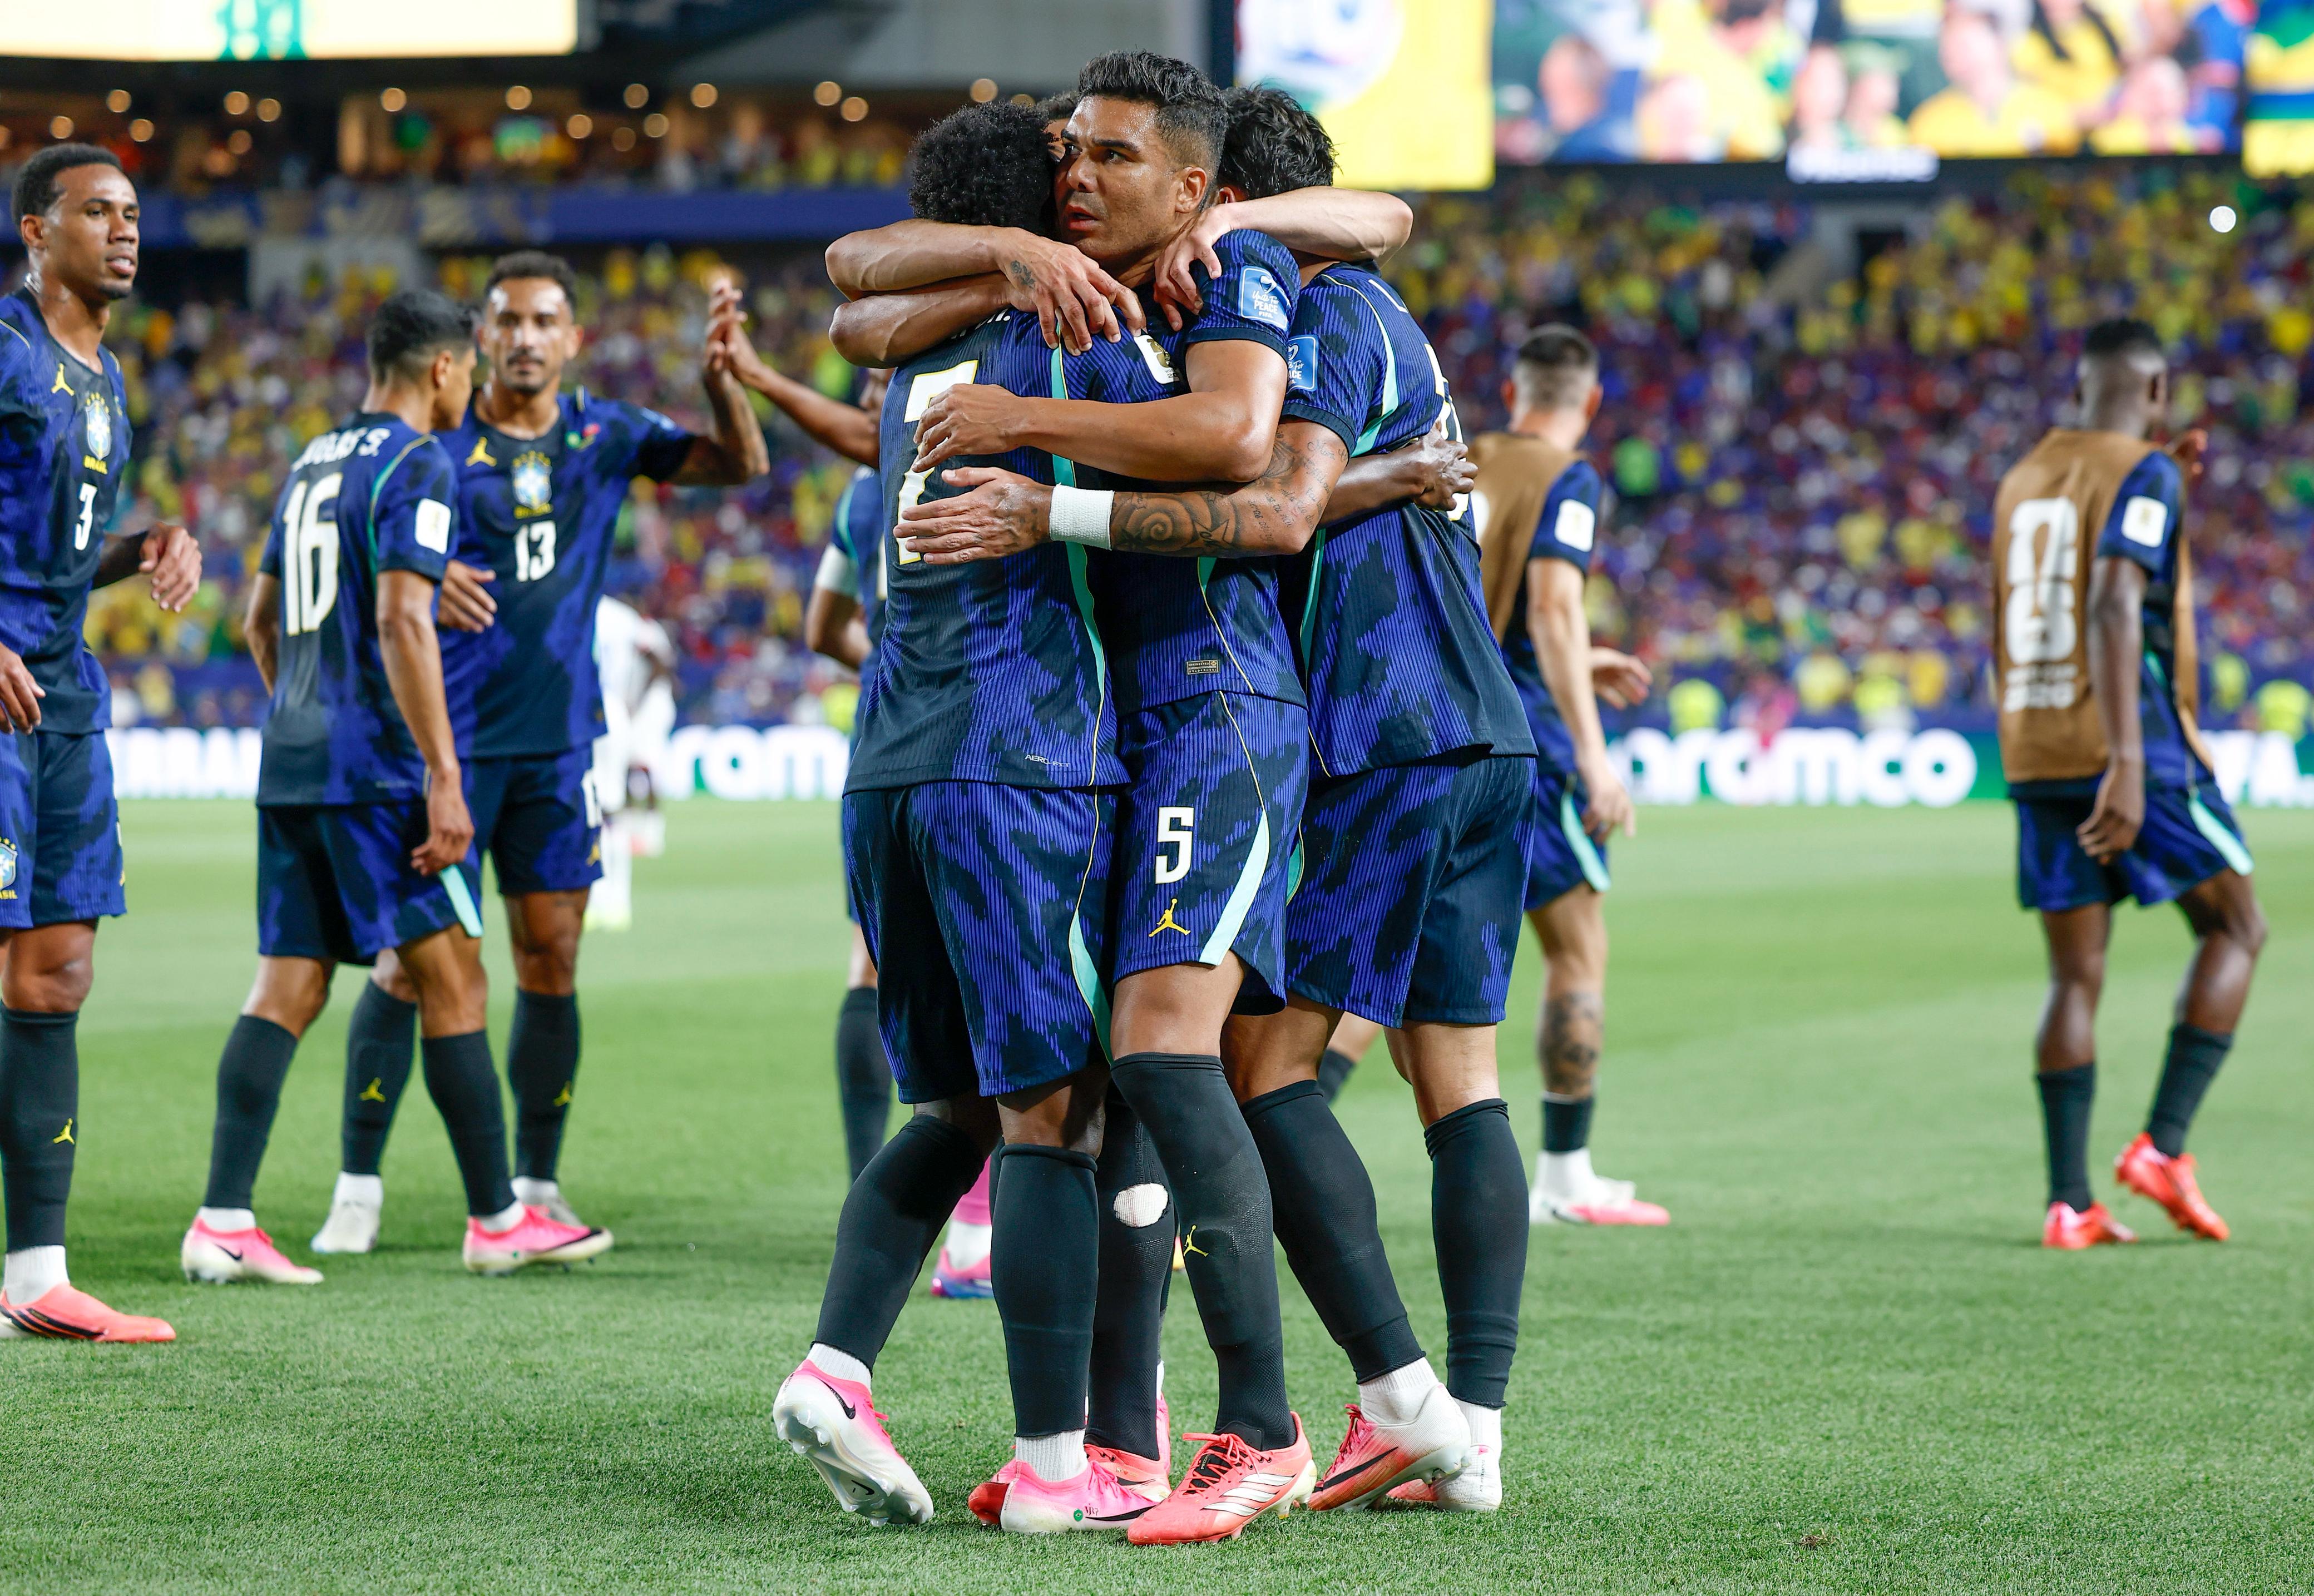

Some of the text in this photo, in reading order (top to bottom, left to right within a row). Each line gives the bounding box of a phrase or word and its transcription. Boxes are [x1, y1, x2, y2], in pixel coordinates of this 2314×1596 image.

[1252, 290, 1279, 305] Unite For
[1254, 300, 1278, 314] PEACE
[1288, 370, 1302, 380] ACE
[1293, 360, 1304, 370] For
[898, 360, 979, 566] 7
[75, 482, 98, 551] 3
[283, 472, 343, 636] 16
[513, 520, 557, 582] 13
[1604, 726, 1979, 808] aramco
[1155, 806, 1194, 884] 5
